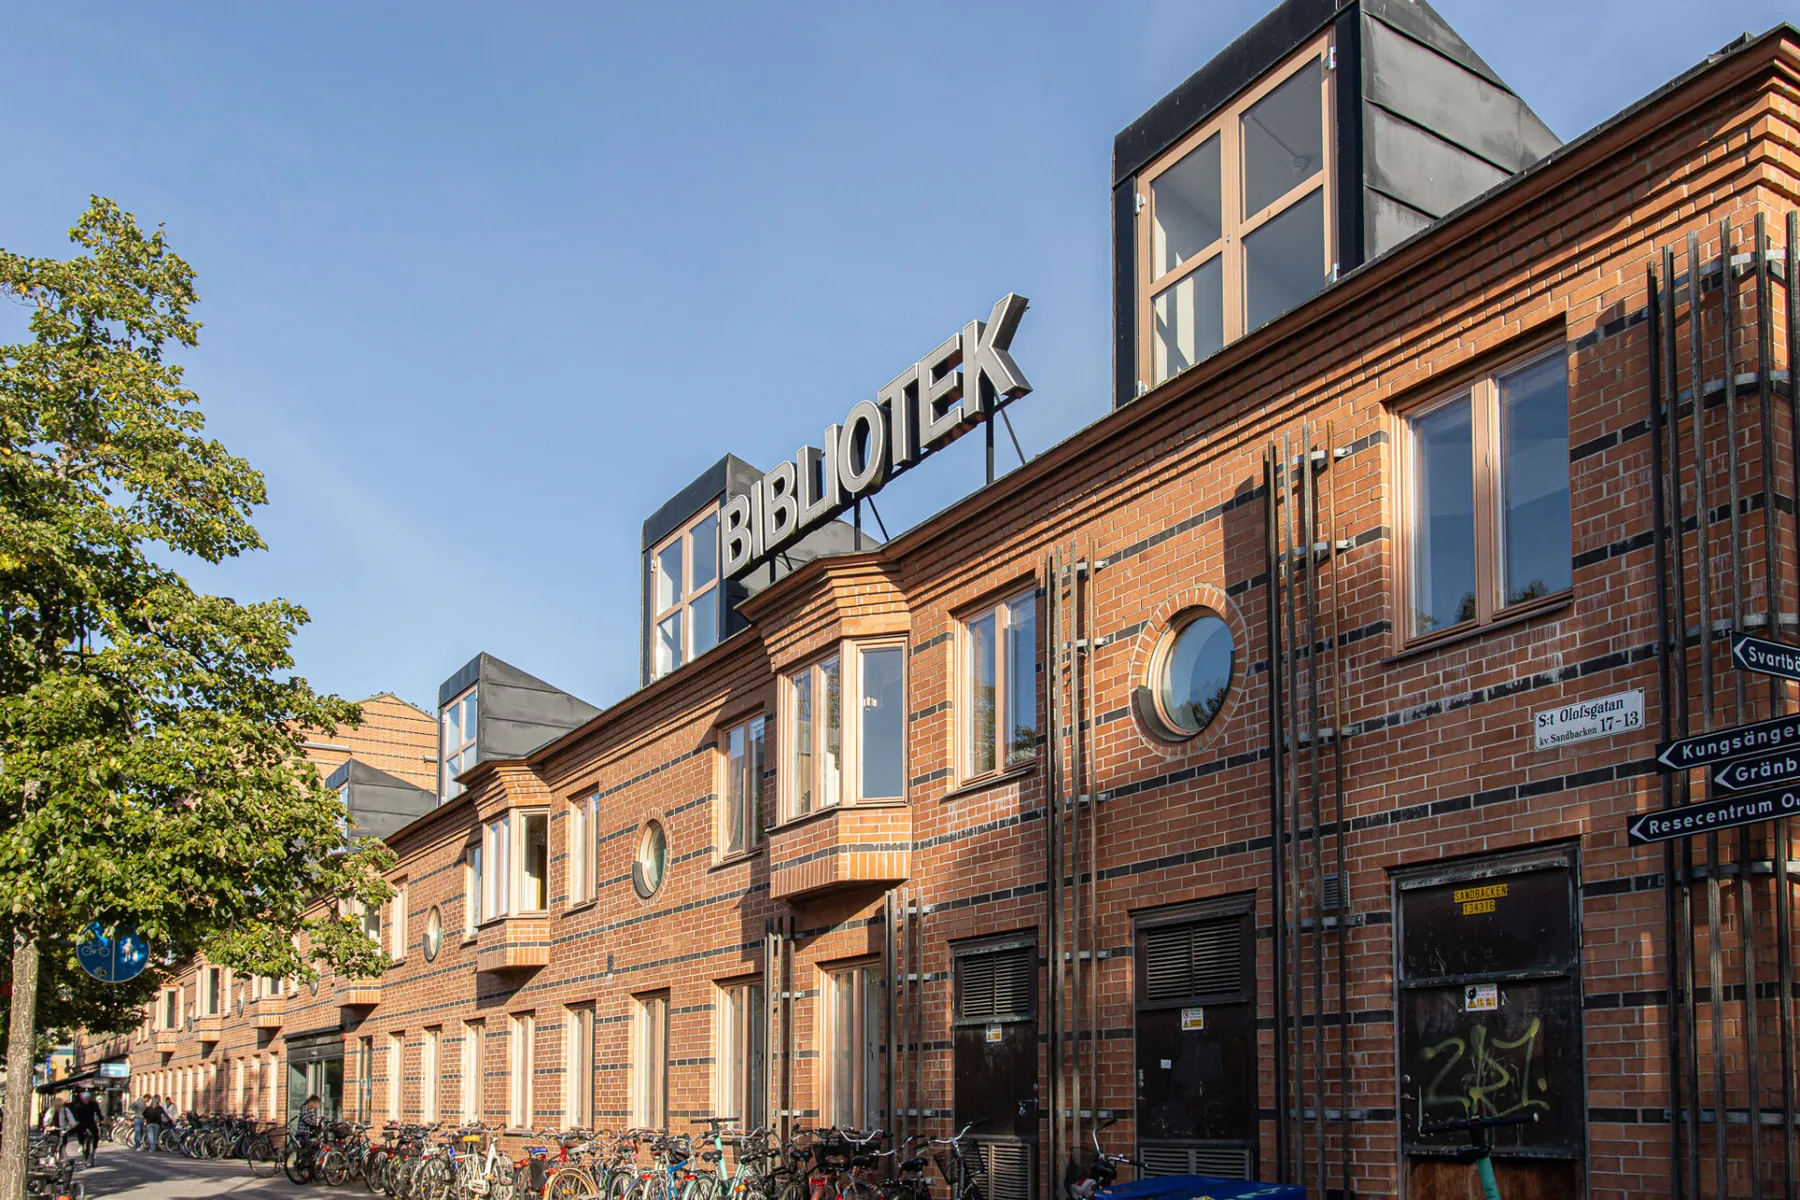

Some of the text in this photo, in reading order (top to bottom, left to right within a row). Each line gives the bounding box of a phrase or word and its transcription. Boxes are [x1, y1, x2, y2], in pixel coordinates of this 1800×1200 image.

[720, 291, 1034, 580] BIBLIOTEK
[1538, 699, 1624, 728] S:t Olofsgatan
[1550, 727, 1598, 743] Sandbacken
[1682, 725, 1800, 760] Kungsänge
[1735, 757, 1797, 781] Gränb
[1649, 800, 1773, 835] Resecentrum
[1454, 885, 1507, 900] SANDBACKEN
